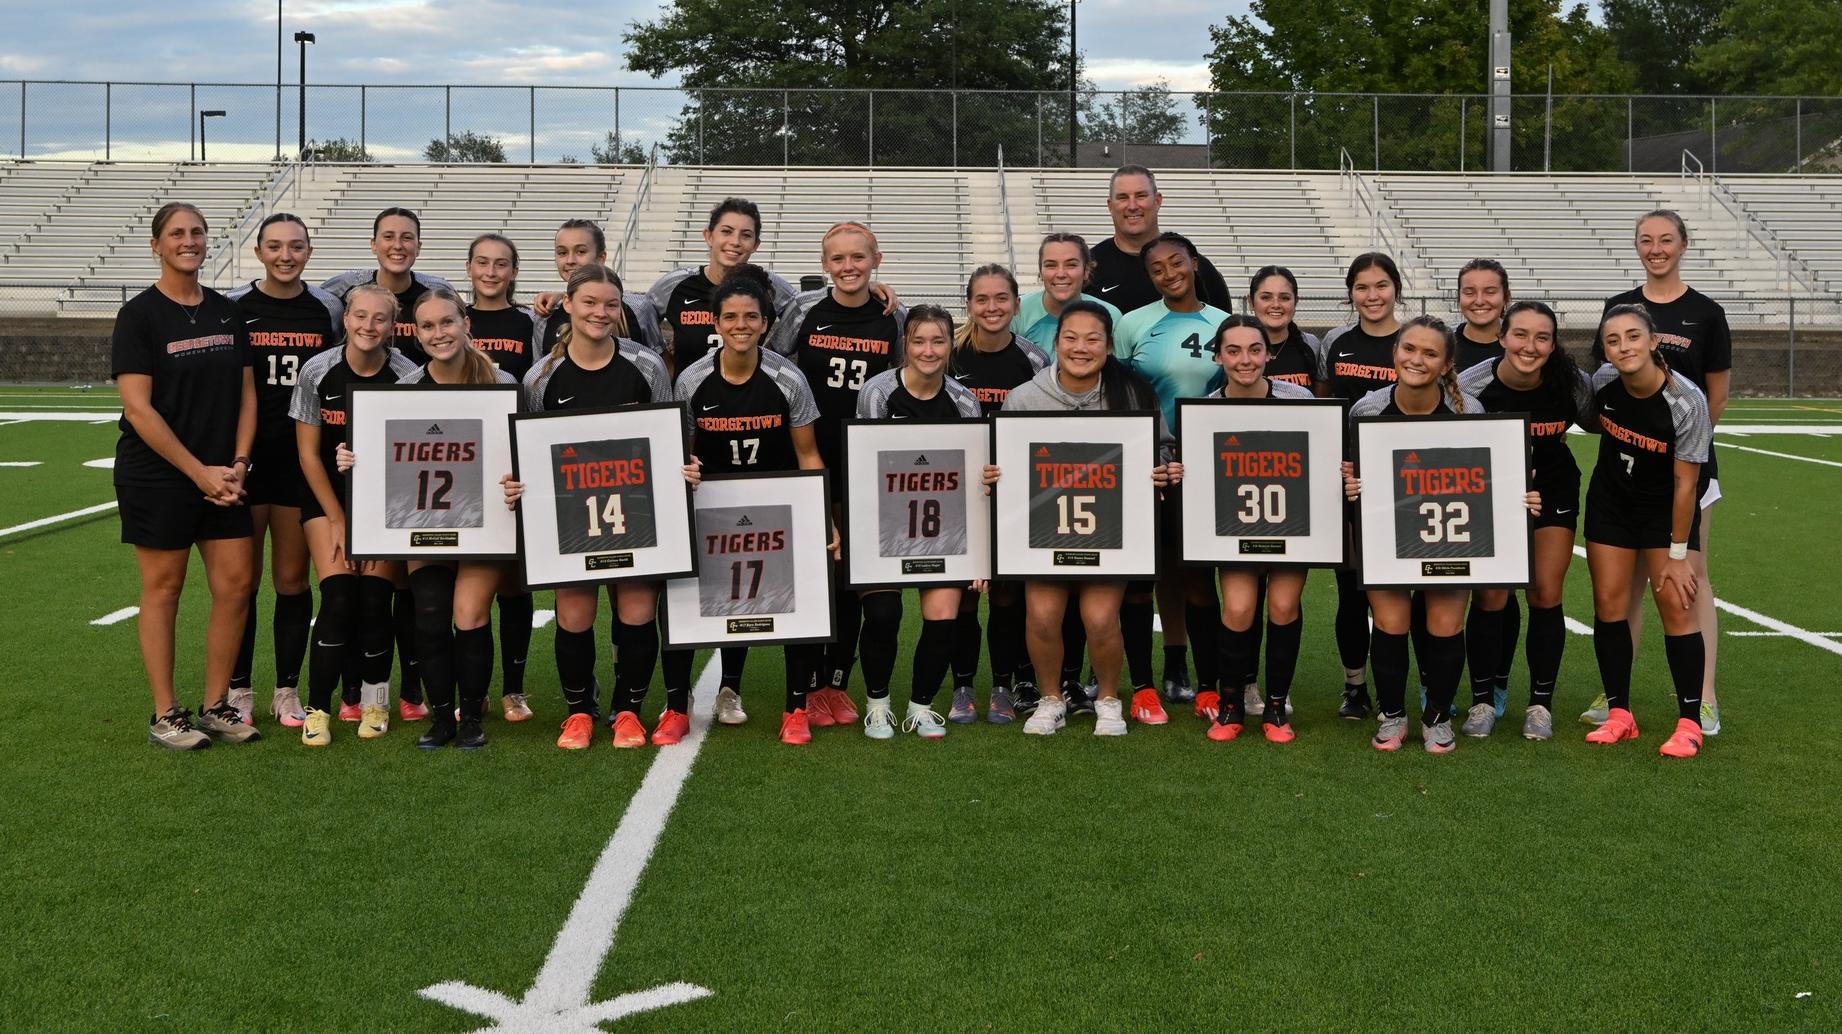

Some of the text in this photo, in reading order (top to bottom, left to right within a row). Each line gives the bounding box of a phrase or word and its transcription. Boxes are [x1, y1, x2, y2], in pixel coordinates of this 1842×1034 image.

[807, 334, 890, 355] GEORGETOWN
[266, 354, 299, 386] 13
[827, 356, 868, 391] 33
[1334, 362, 1398, 382] GEORGETOW
[696, 414, 782, 431] GEORGETOWN
[392, 441, 477, 463] TIGERS
[729, 438, 760, 465] 17
[1220, 450, 1303, 478] TIGERS
[1620, 452, 1635, 475] 7
[560, 458, 646, 491] TIGERS
[885, 470, 960, 494] TIGERS
[1034, 463, 1117, 489] TIGERS
[1400, 466, 1487, 496] TIGERS
[415, 469, 455, 511] 12
[1236, 483, 1287, 524] 30
[584, 493, 627, 538] 14
[907, 498, 942, 540] 18
[1056, 494, 1097, 535] 15
[1418, 501, 1472, 543] 32
[704, 529, 786, 556] TIGERS
[729, 558, 765, 601] 17
